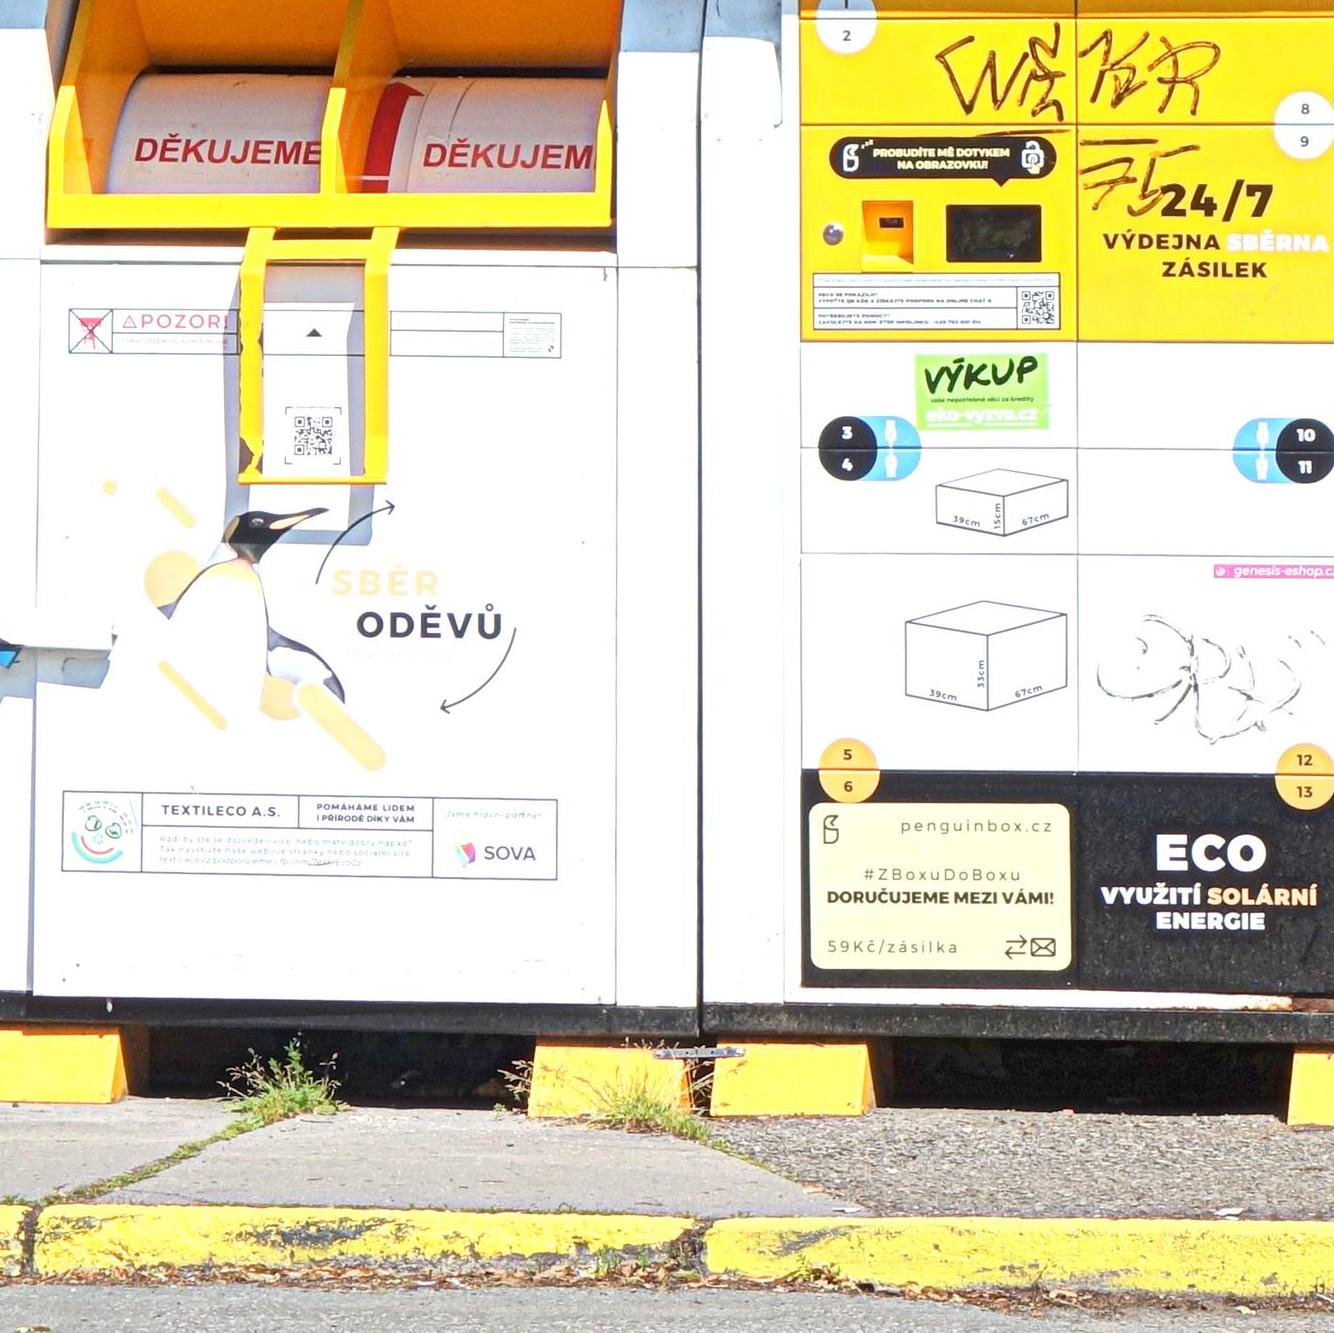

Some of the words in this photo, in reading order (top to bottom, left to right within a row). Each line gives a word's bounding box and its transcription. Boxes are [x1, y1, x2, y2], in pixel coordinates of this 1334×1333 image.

[842, 30, 851, 41] 2
[1301, 103, 1310, 114] 8
[1300, 136, 1309, 147] 9
[134, 133, 320, 165] DĚKUJEME
[423, 137, 596, 170] DĚKUJEM
[873, 147, 936, 158] PROBUDÍTE
[937, 146, 955, 158] MĚ
[956, 148, 1010, 158] DOTYKEM
[897, 160, 914, 169] NA
[916, 160, 988, 170] OBRAZOVKU!
[1161, 179, 1273, 222] 24/7
[1103, 227, 1220, 251] VÝDEJNA
[1227, 229, 1329, 252] SBĚRNA
[1162, 257, 1268, 278] ZÁSILEK
[141, 313, 230, 329] POZOR!
[924, 356, 1038, 394] VÝKUP
[841, 426, 853, 440] 3
[1296, 429, 1316, 442] 10
[841, 458, 854, 471] 4
[1298, 460, 1312, 474] 11
[953, 515, 980, 527] 39cm
[994, 502, 1002, 529] 15cm
[1021, 513, 1049, 527] 67cm
[331, 563, 439, 597] SBĚR
[356, 602, 502, 640] ODĚVŮ
[977, 659, 985, 687] 33cm
[929, 688, 957, 701] 39cm
[1015, 684, 1043, 698] 67cm
[843, 749, 852, 760] 5
[1297, 754, 1314, 766] 12
[843, 780, 853, 792] 6
[1297, 786, 1313, 798] 13
[162, 805, 246, 816] TEXTILECO
[251, 806, 281, 817] A.S.
[316, 802, 378, 812] POMÁHÁME
[382, 804, 415, 812] LIDEM
[366, 814, 390, 823] DÍKY
[392, 813, 415, 823] VÁM
[901, 821, 1052, 834] penguinbox.cz
[484, 846, 536, 861] SOVA
[1156, 833, 1267, 872] ECO
[864, 868, 1020, 882] #ZBoxuDoBoxu
[827, 888, 949, 906] DORUČUJEME
[954, 891, 997, 904] MEZI
[1002, 889, 1054, 905] VÁMI!
[1100, 883, 1201, 905] VYUŽITÍ
[1207, 883, 1318, 906] SOLÁRNÍ
[1156, 912, 1265, 930] ENERGIE
[828, 939, 957, 955] 59Kč/zásilka
